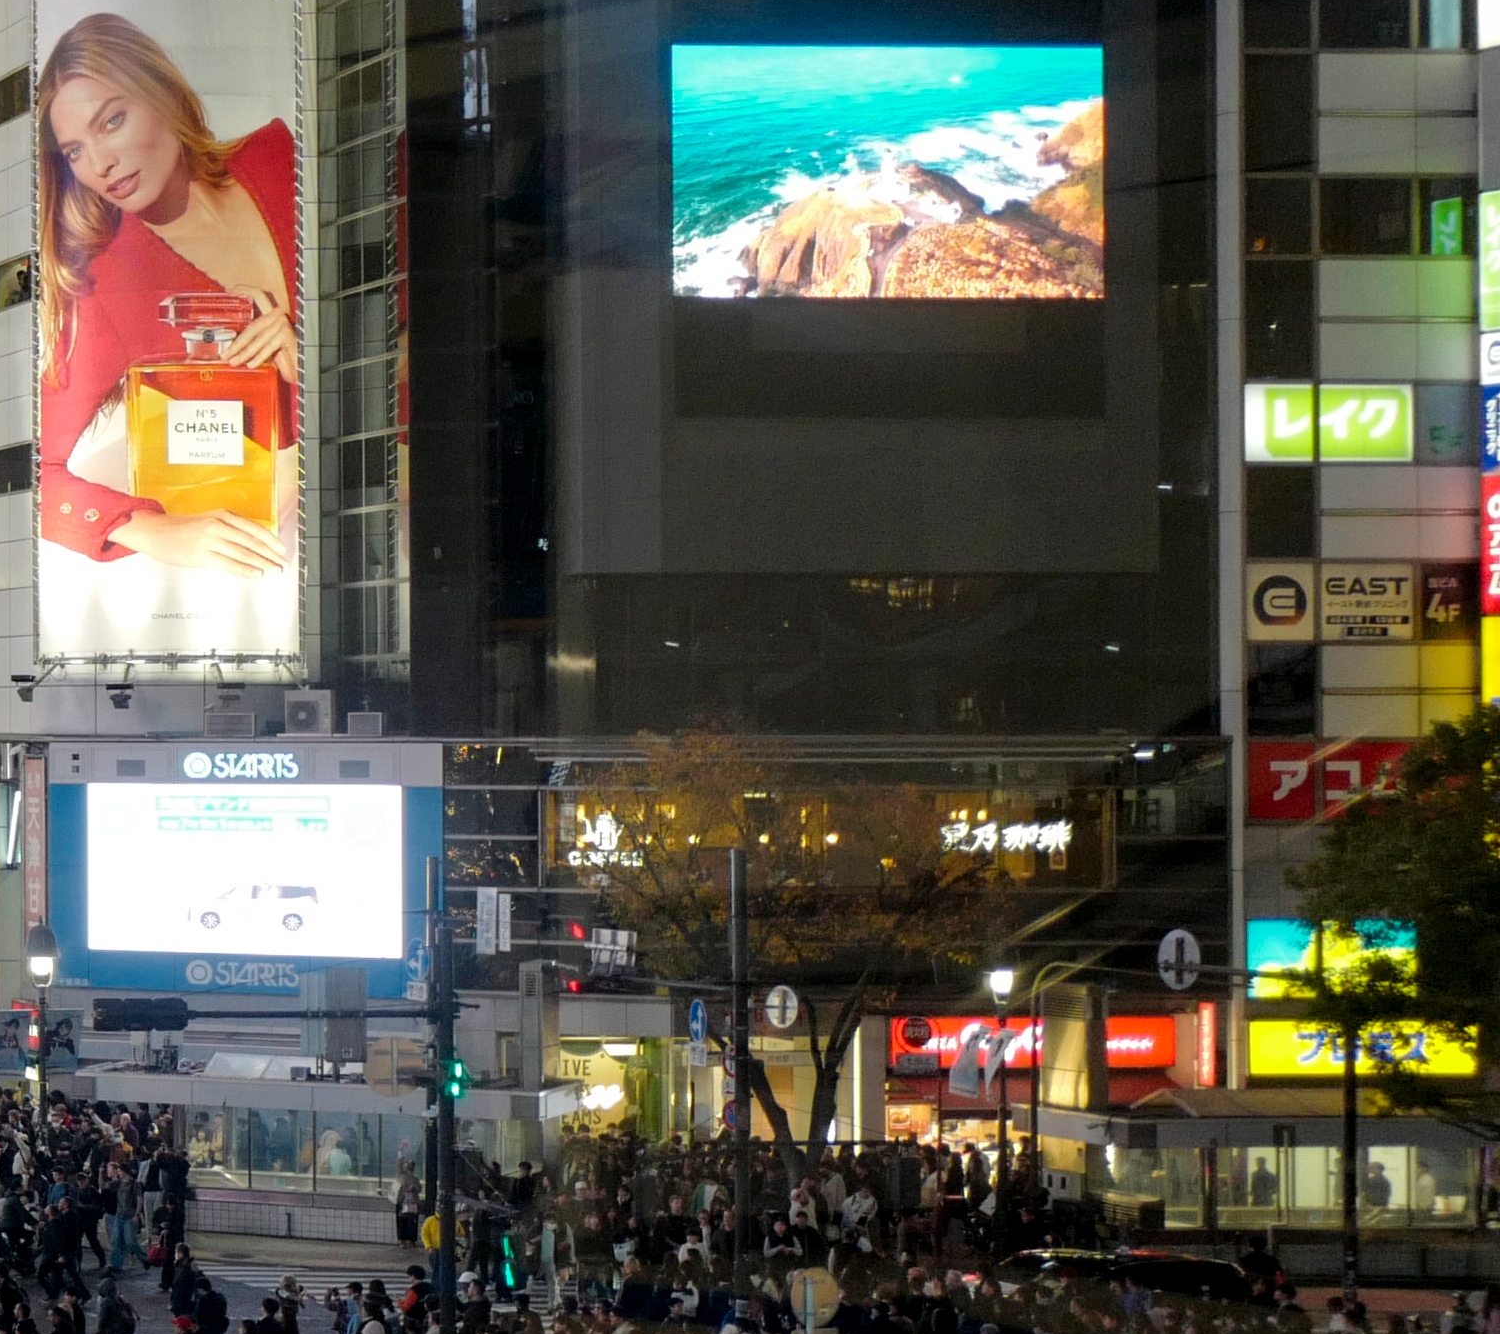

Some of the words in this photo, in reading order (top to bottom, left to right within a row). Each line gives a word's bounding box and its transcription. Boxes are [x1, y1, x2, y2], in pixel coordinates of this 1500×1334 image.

[174, 421, 239, 435] CHANEL
[1272, 398, 1400, 441] レイク
[1325, 576, 1409, 596] EAST
[1426, 592, 1461, 623] 4F
[213, 753, 300, 779] STARTS
[215, 960, 300, 987] STARTS
